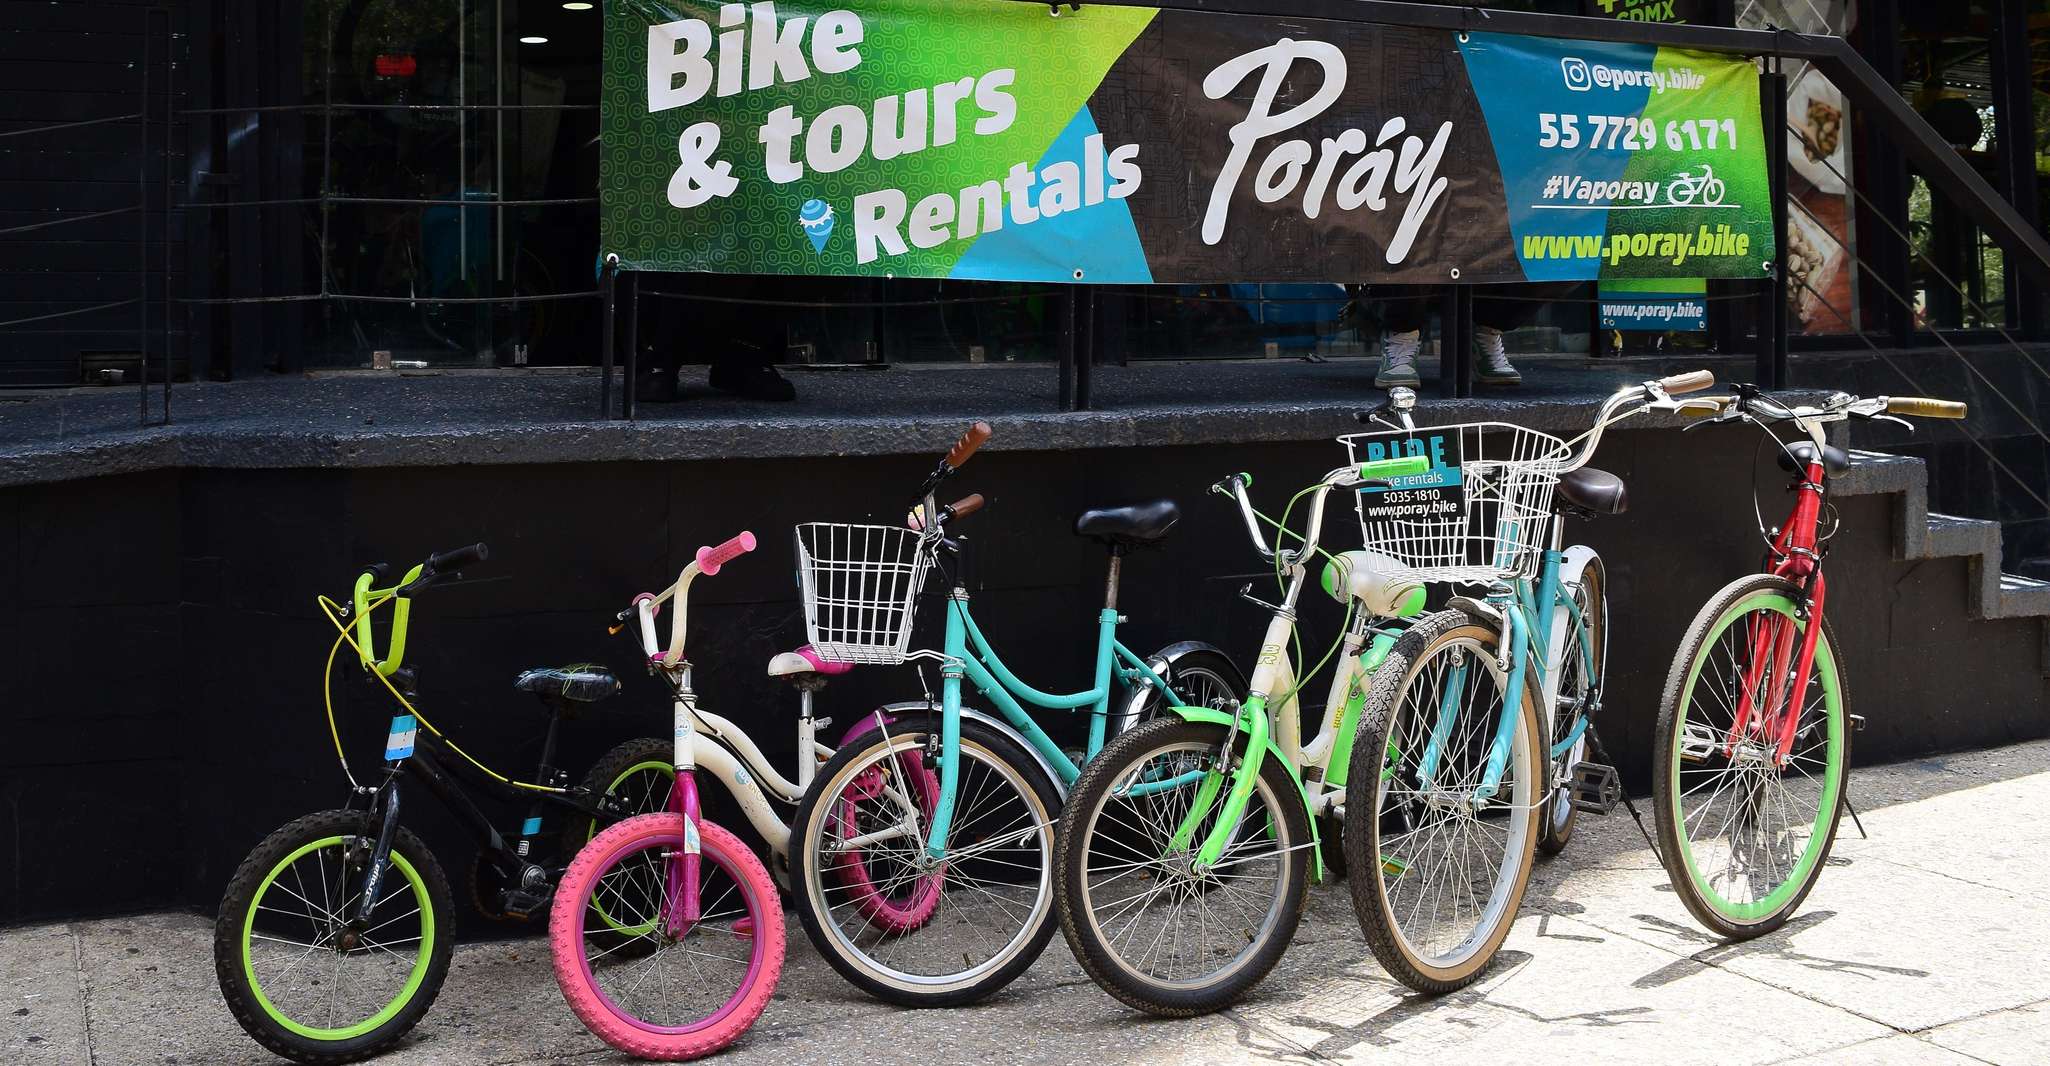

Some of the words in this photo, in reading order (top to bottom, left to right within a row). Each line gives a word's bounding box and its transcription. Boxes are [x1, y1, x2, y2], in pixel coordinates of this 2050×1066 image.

[648, 1, 864, 113] Bike
[1593, 65, 1705, 92] @poray.bike
[667, 122, 740, 209] &
[758, 68, 1017, 184] tours
[1539, 113, 1580, 149] 55
[1588, 116, 1657, 150] 7729
[1665, 118, 1737, 151] 6171
[1201, 38, 1453, 264] Poráy
[853, 133, 1142, 265] Rentals
[1543, 175, 1660, 204] #Vaporay
[1523, 224, 1749, 266] www.poray.bike
[1602, 303, 1703, 321] www.poray.bike
[1403, 472, 1443, 486] rentals
[1368, 500, 1457, 518] www.poray.bike
[1383, 489, 1440, 504] 5035-1810
